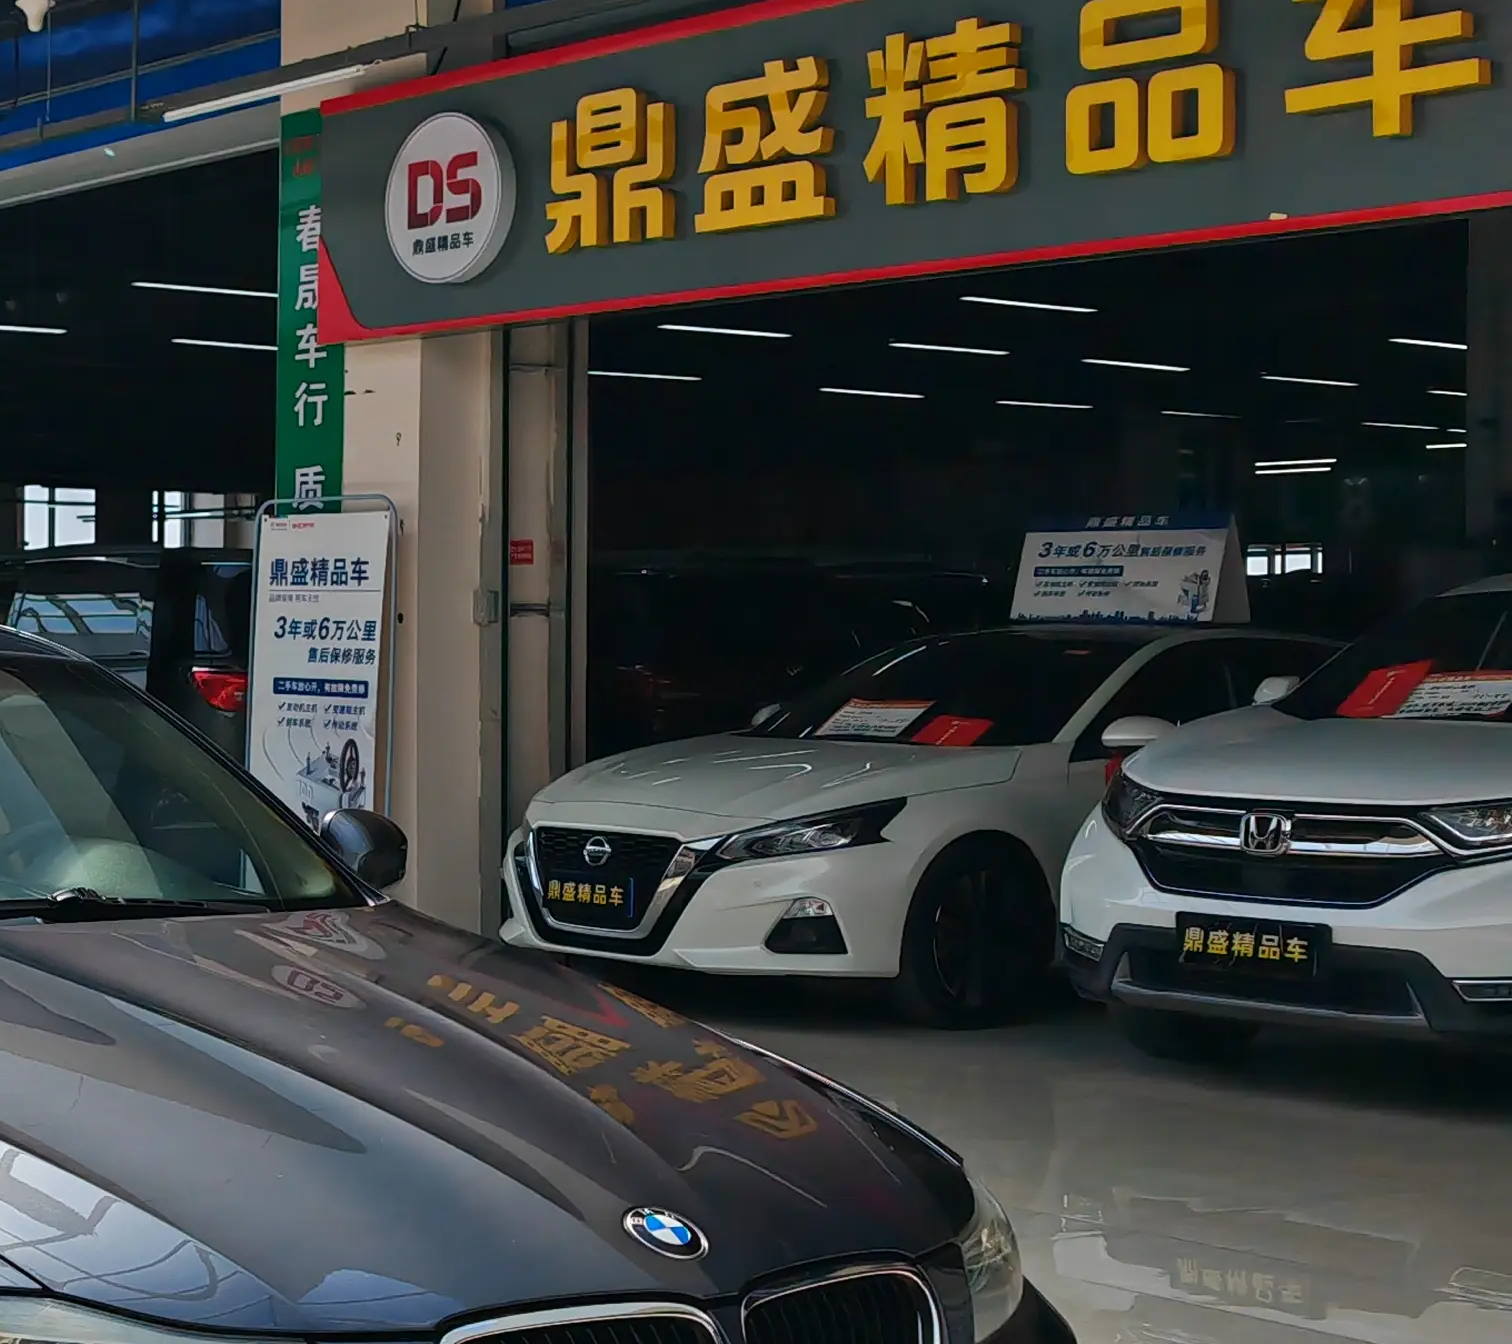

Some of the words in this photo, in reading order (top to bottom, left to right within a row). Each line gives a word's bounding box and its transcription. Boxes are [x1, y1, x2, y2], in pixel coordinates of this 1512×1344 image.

[407, 151, 482, 230] DS
[411, 231, 475, 256] 鼎盛精品车
[269, 557, 370, 587] 鼎盛精品车
[274, 616, 378, 642] 3年或6万公里
[307, 646, 376, 665] 售后保修服务
[547, 879, 625, 907] 鼎盛精品车
[1183, 926, 1309, 963] 鼎盛精品车
